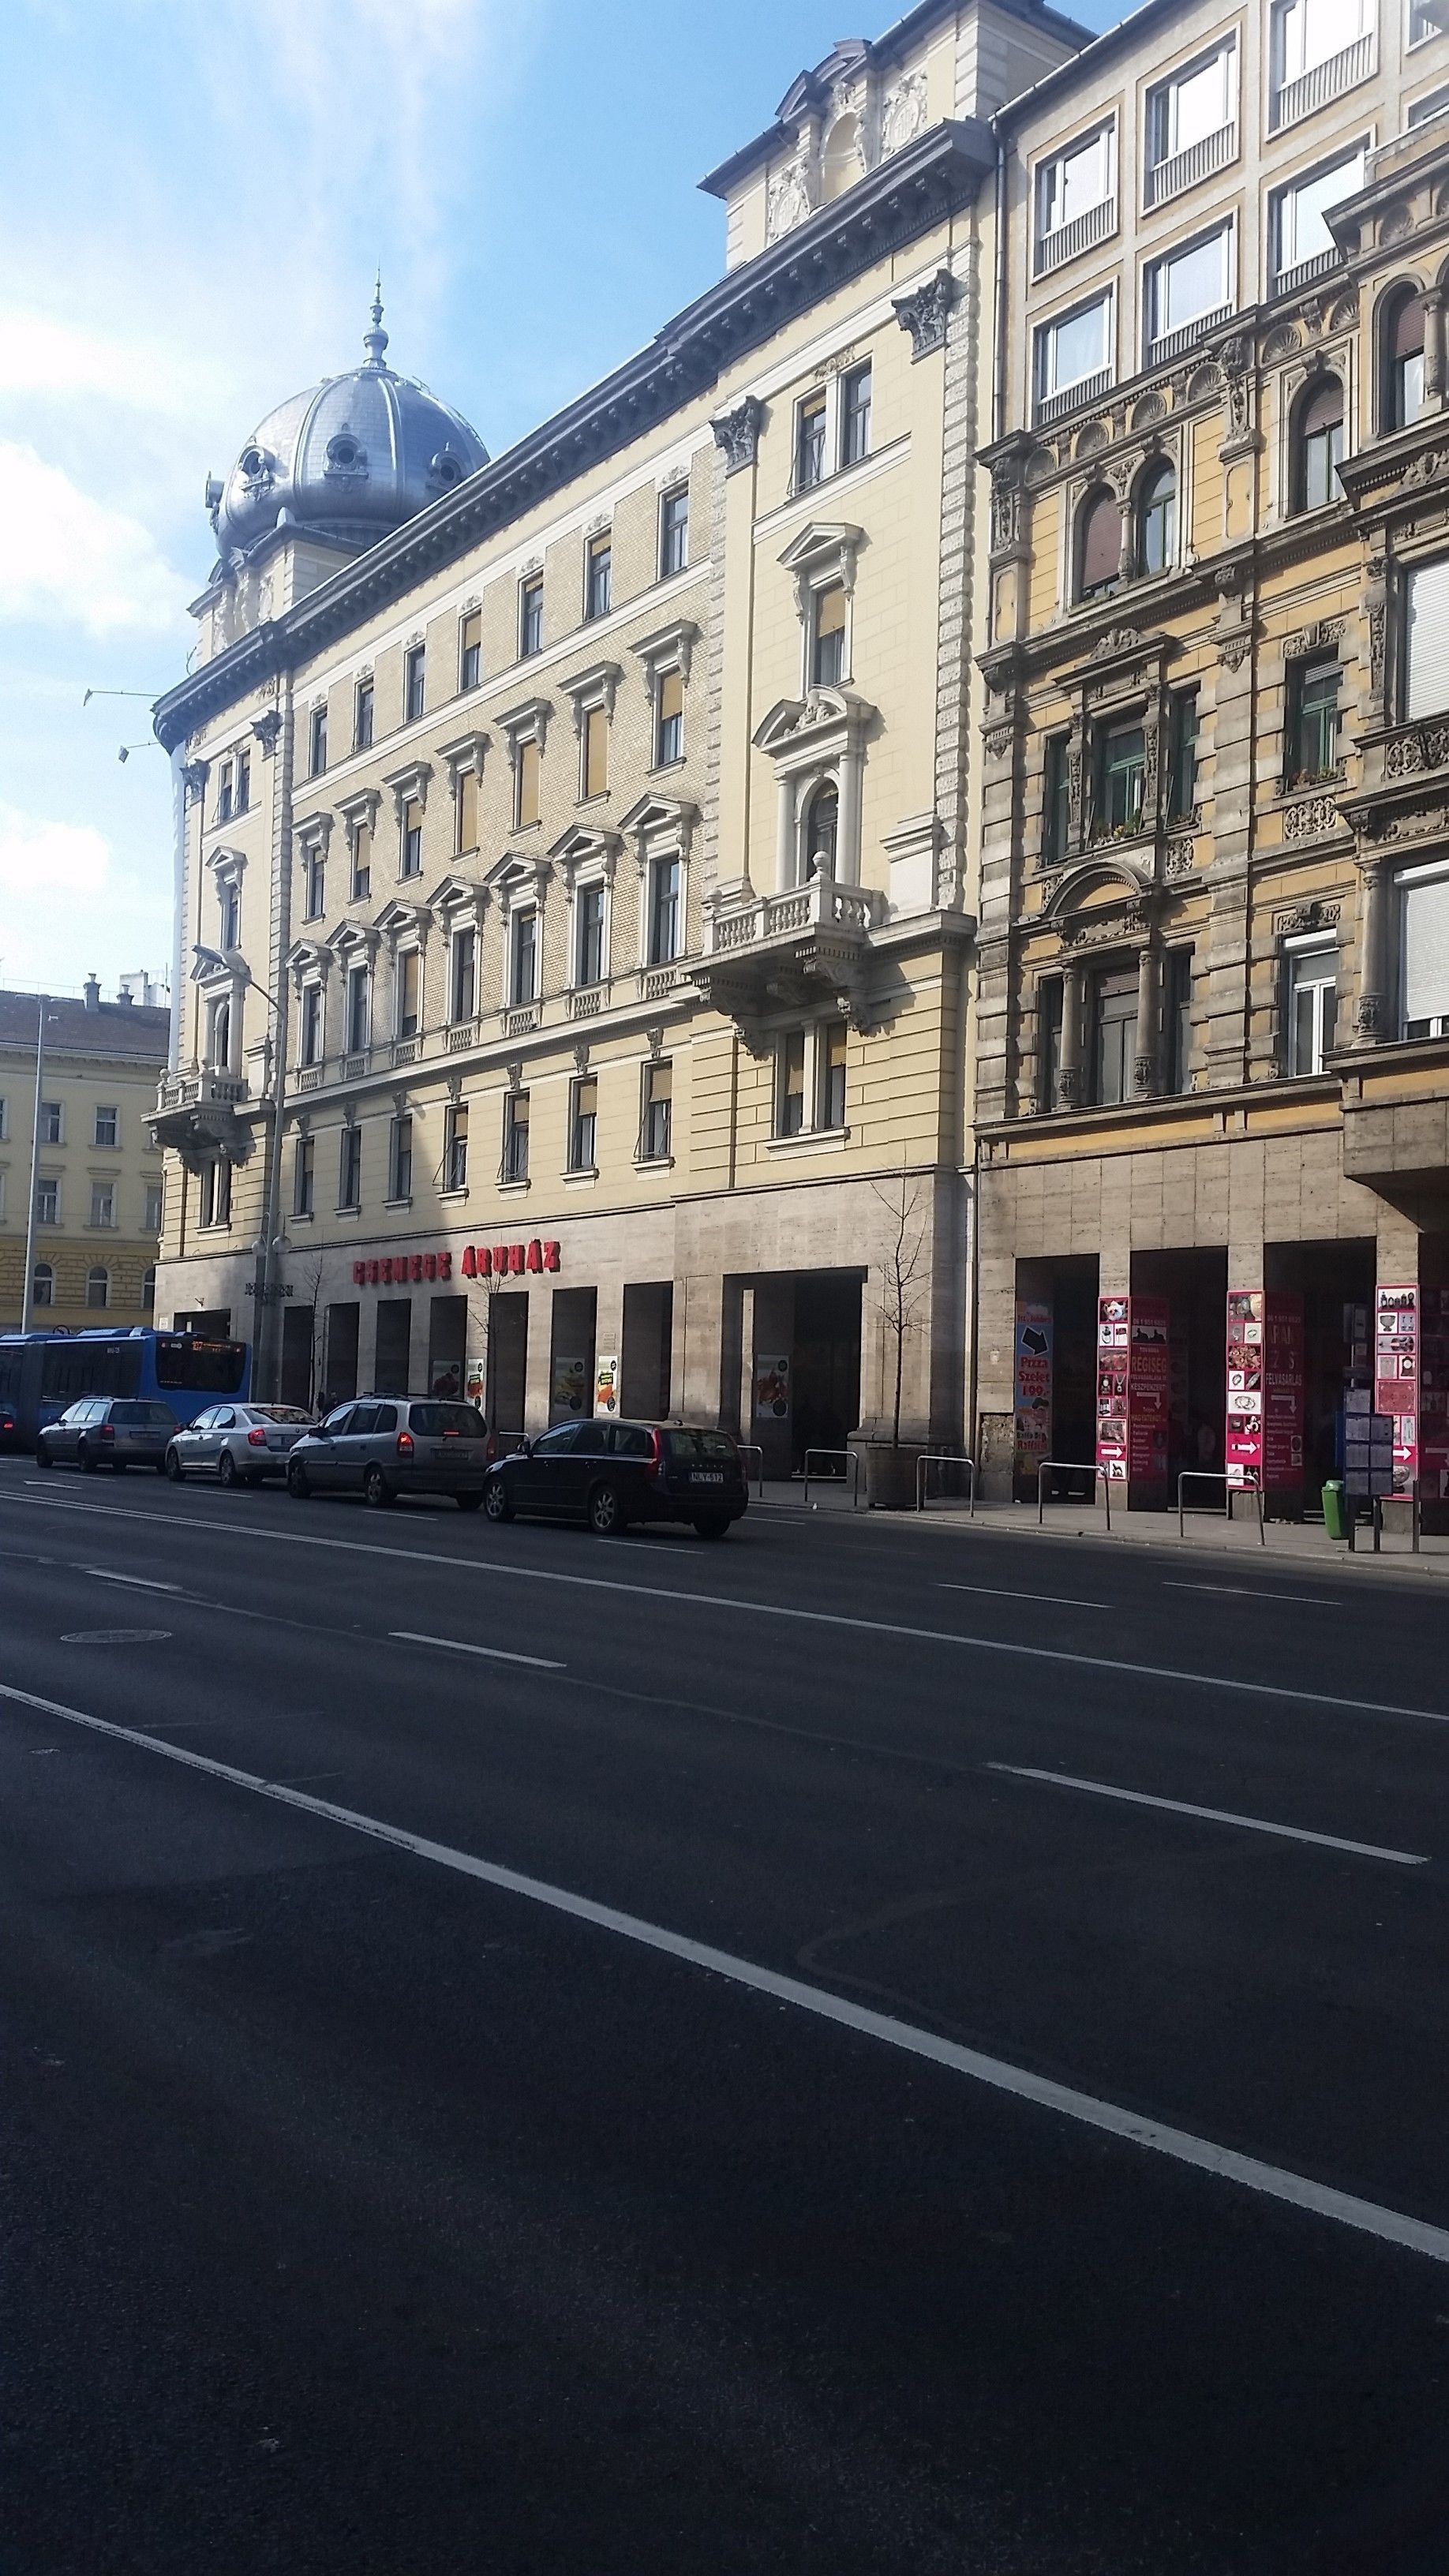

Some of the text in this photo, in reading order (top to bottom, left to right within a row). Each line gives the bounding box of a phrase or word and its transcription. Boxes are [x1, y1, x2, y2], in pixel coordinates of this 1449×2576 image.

[353, 1251, 452, 1285] CSEMEGE
[1020, 1357, 1048, 1368] Pizza
[1018, 1370, 1050, 1382] Szelet
